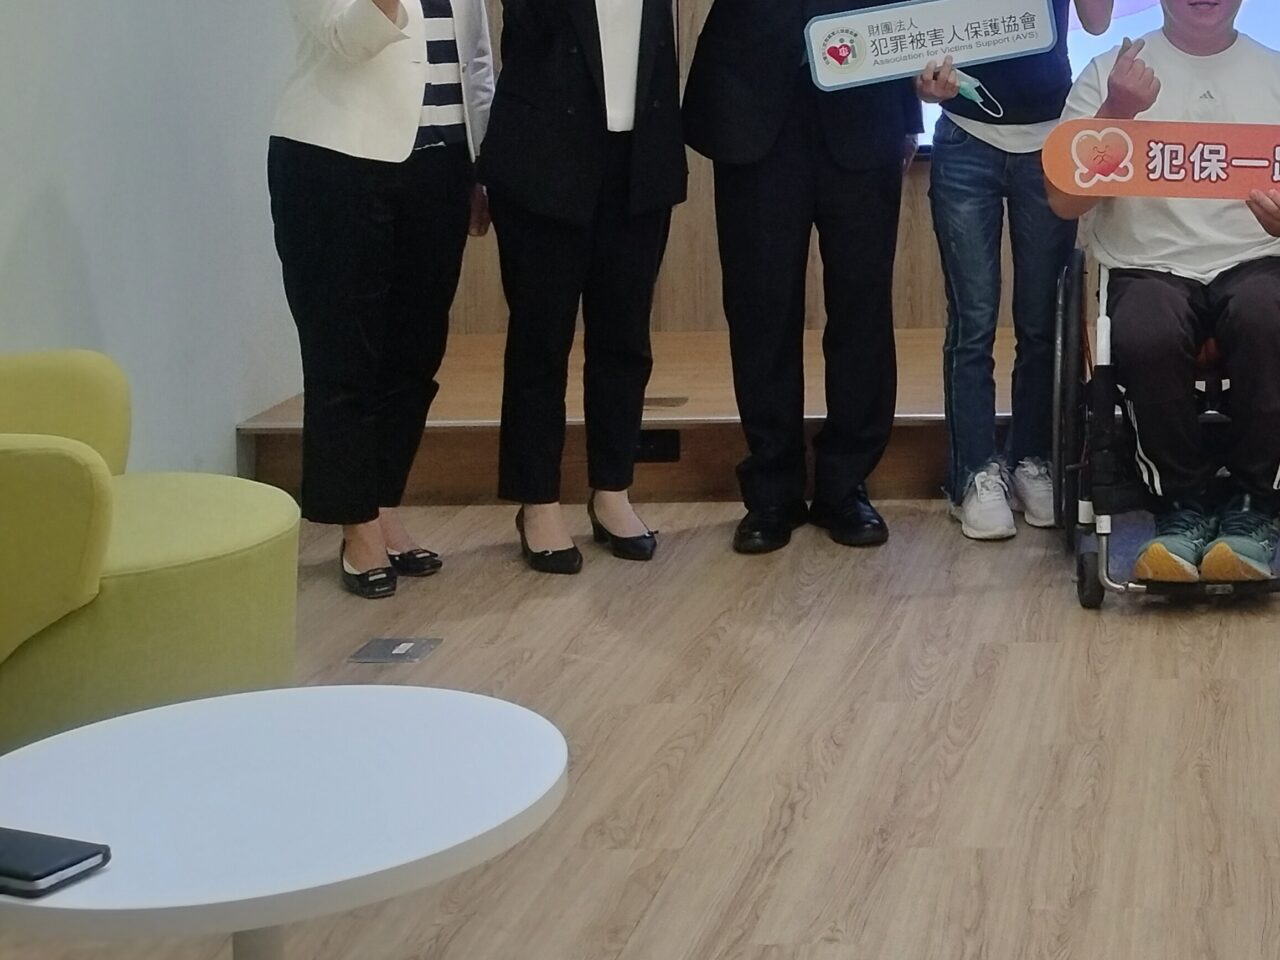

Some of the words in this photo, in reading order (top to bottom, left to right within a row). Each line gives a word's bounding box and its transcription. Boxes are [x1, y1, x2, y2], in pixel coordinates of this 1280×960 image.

[867, 17, 918, 37] 財團法人
[870, 11, 1037, 57] 犯罪被害人保護協會
[872, 52, 925, 67] Association
[926, 49, 939, 57] for
[940, 43, 974, 54] Victims
[975, 36, 1011, 48] Support
[1012, 31, 1039, 44] (AVS)
